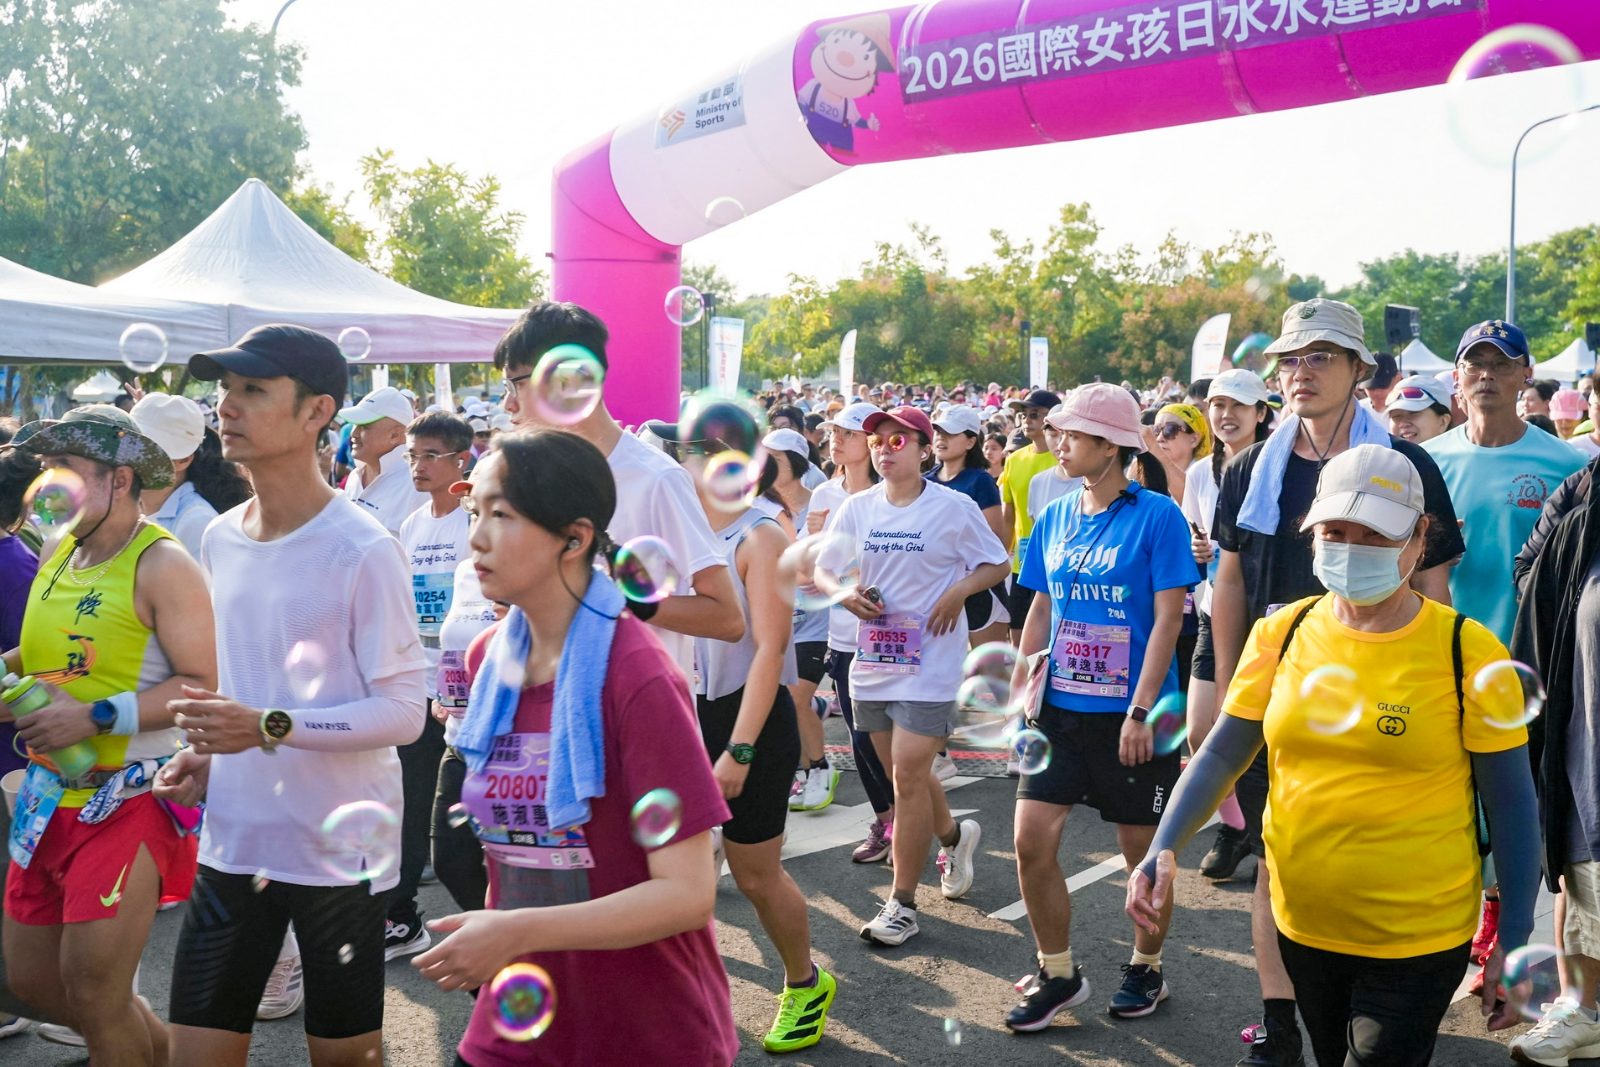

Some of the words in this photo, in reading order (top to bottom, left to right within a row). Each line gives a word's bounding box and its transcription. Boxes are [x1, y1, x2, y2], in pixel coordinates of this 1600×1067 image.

[903, 0, 1462, 94] 2026國際女孩日水水運
[696, 101, 730, 118] Ministry
[819, 101, 840, 118] 520
[695, 114, 725, 128] Sports
[868, 529, 922, 539] International
[864, 541, 880, 553] Day
[881, 542, 890, 553] of
[891, 543, 904, 551] the
[906, 541, 925, 552] Girl
[415, 590, 447, 603] 10254
[1071, 583, 1123, 603] RIVER
[869, 630, 907, 643] 20535
[1065, 641, 1111, 659] 20317
[1377, 702, 1410, 714] GUCCI
[484, 774, 548, 800] 20807
[1153, 785, 1164, 813] ECHT
